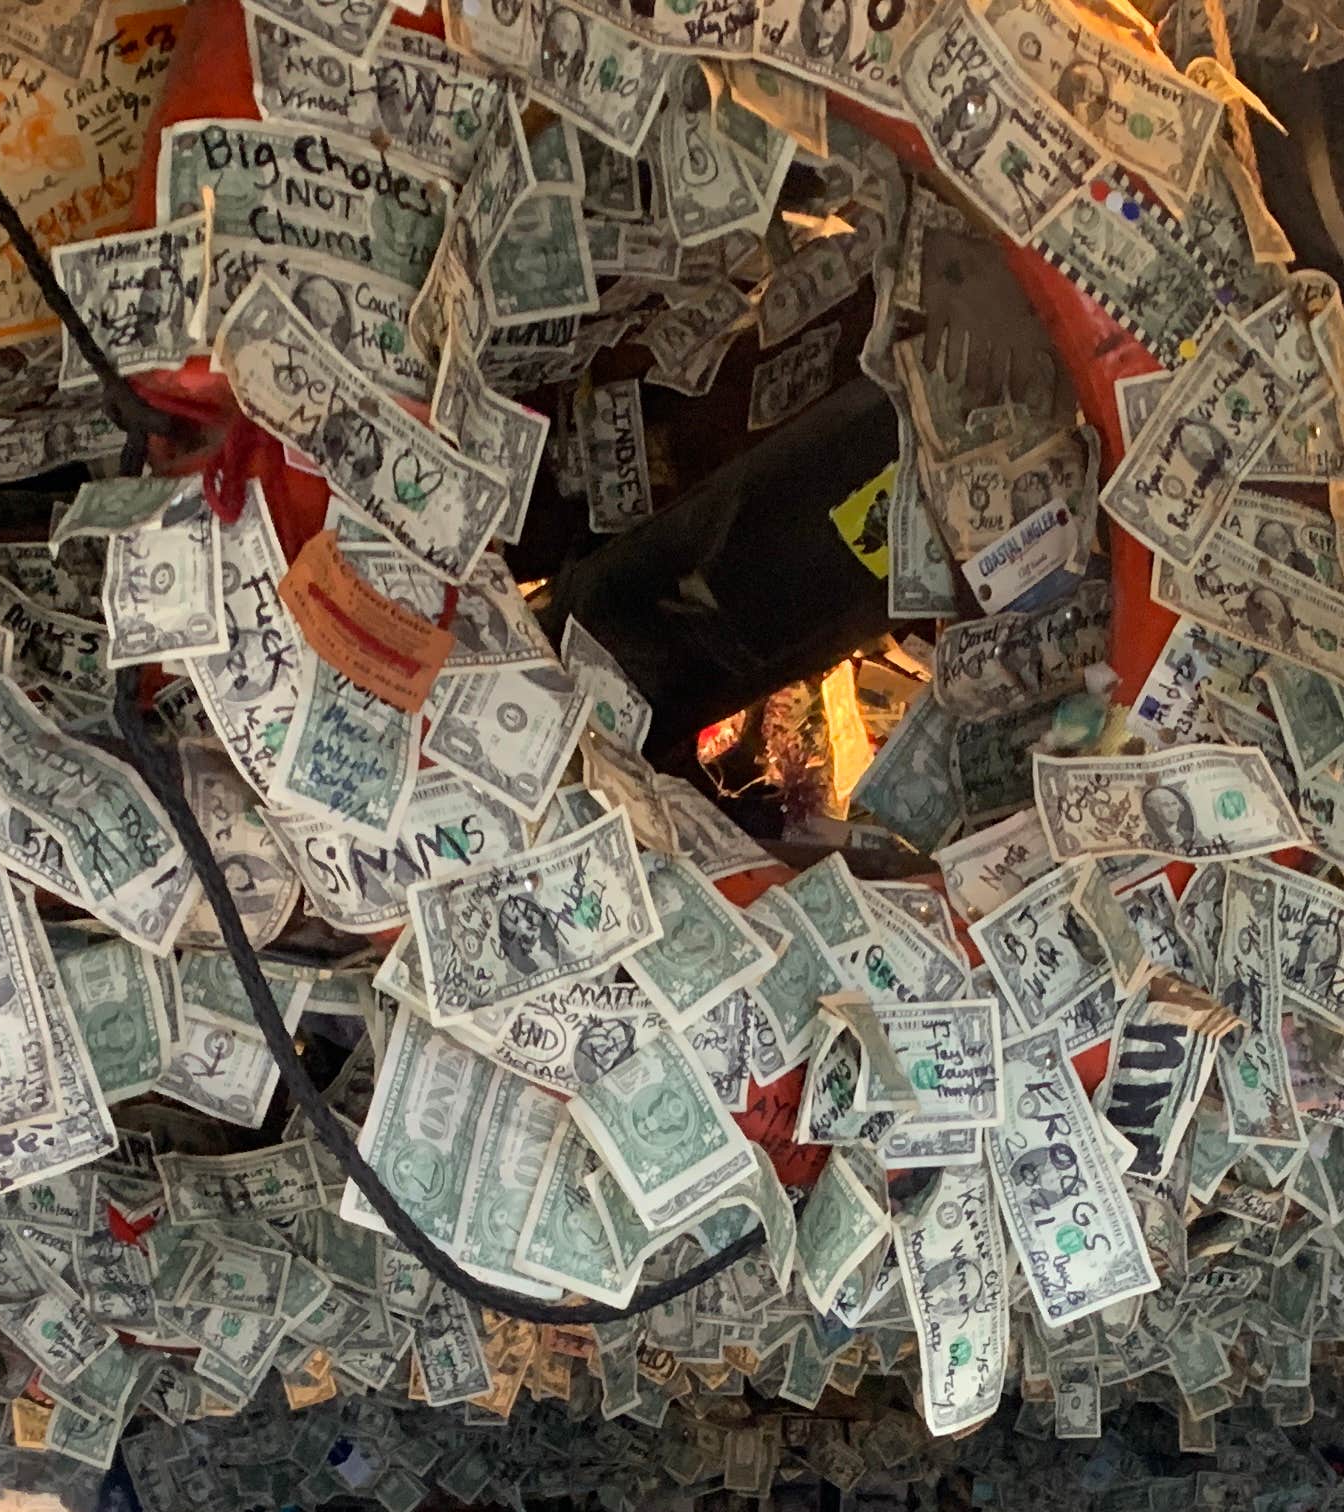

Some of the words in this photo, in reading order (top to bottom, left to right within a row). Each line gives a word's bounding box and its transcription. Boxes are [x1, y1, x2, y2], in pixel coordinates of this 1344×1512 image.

[202, 125, 280, 188] Big
[294, 135, 432, 217] Chodes
[285, 179, 355, 219] NOT
[249, 206, 373, 262] Chums
[611, 389, 646, 517] LINDSEY
[978, 539, 1023, 577] COASTAL
[1019, 510, 1060, 547] ANGLER
[568, 983, 640, 1006] MATT
